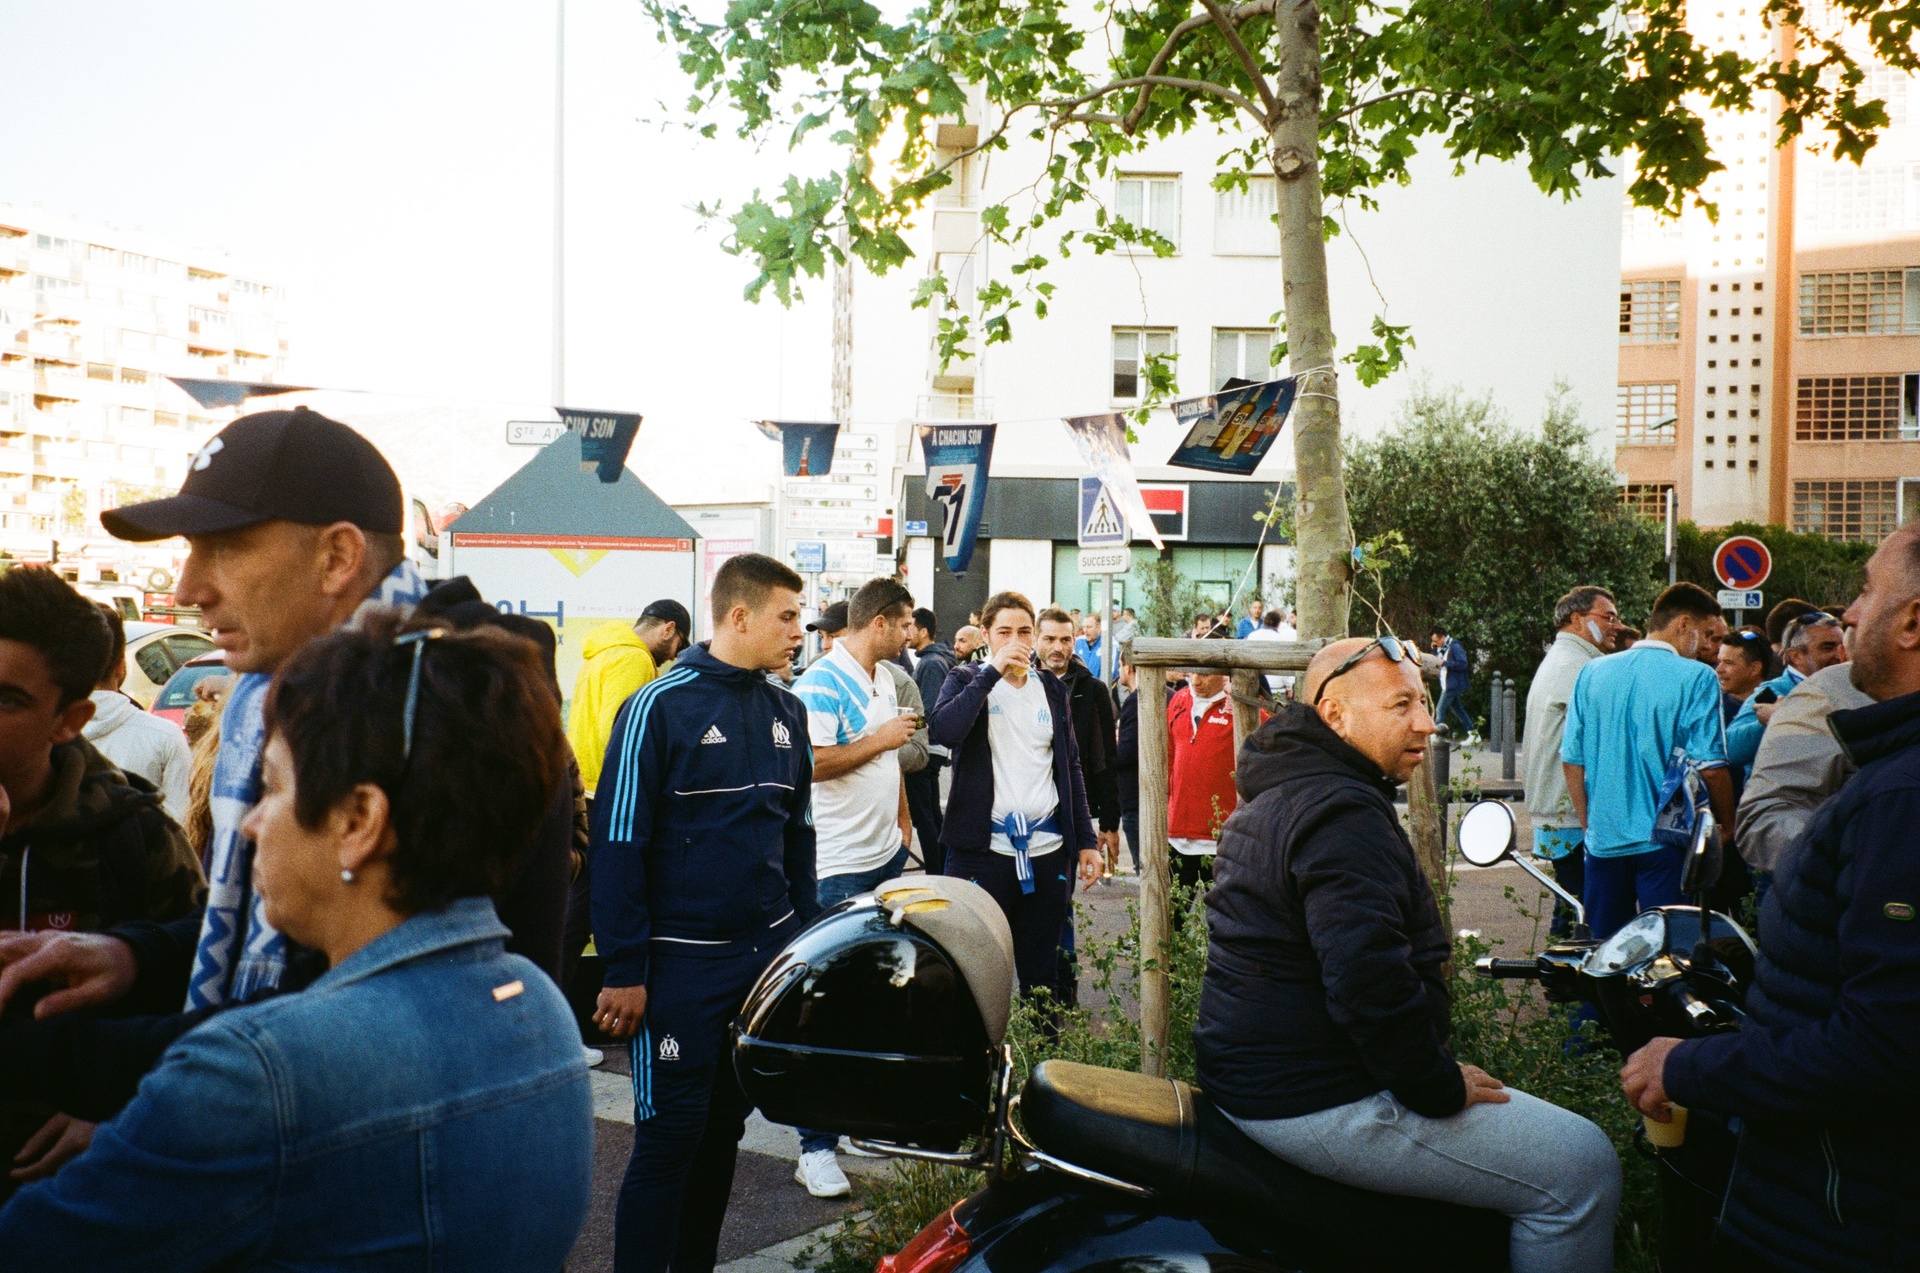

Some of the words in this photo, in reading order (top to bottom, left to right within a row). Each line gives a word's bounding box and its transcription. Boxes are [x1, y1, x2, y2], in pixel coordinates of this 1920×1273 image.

[1234, 413, 1246, 423] 51
[589, 416, 617, 439] SON
[931, 427, 938, 446] À
[938, 429, 967, 446] CHACUN
[968, 428, 983, 445] SON
[1082, 555, 1123, 567] SUCCESSIF
[700, 736, 728, 745] adidas
